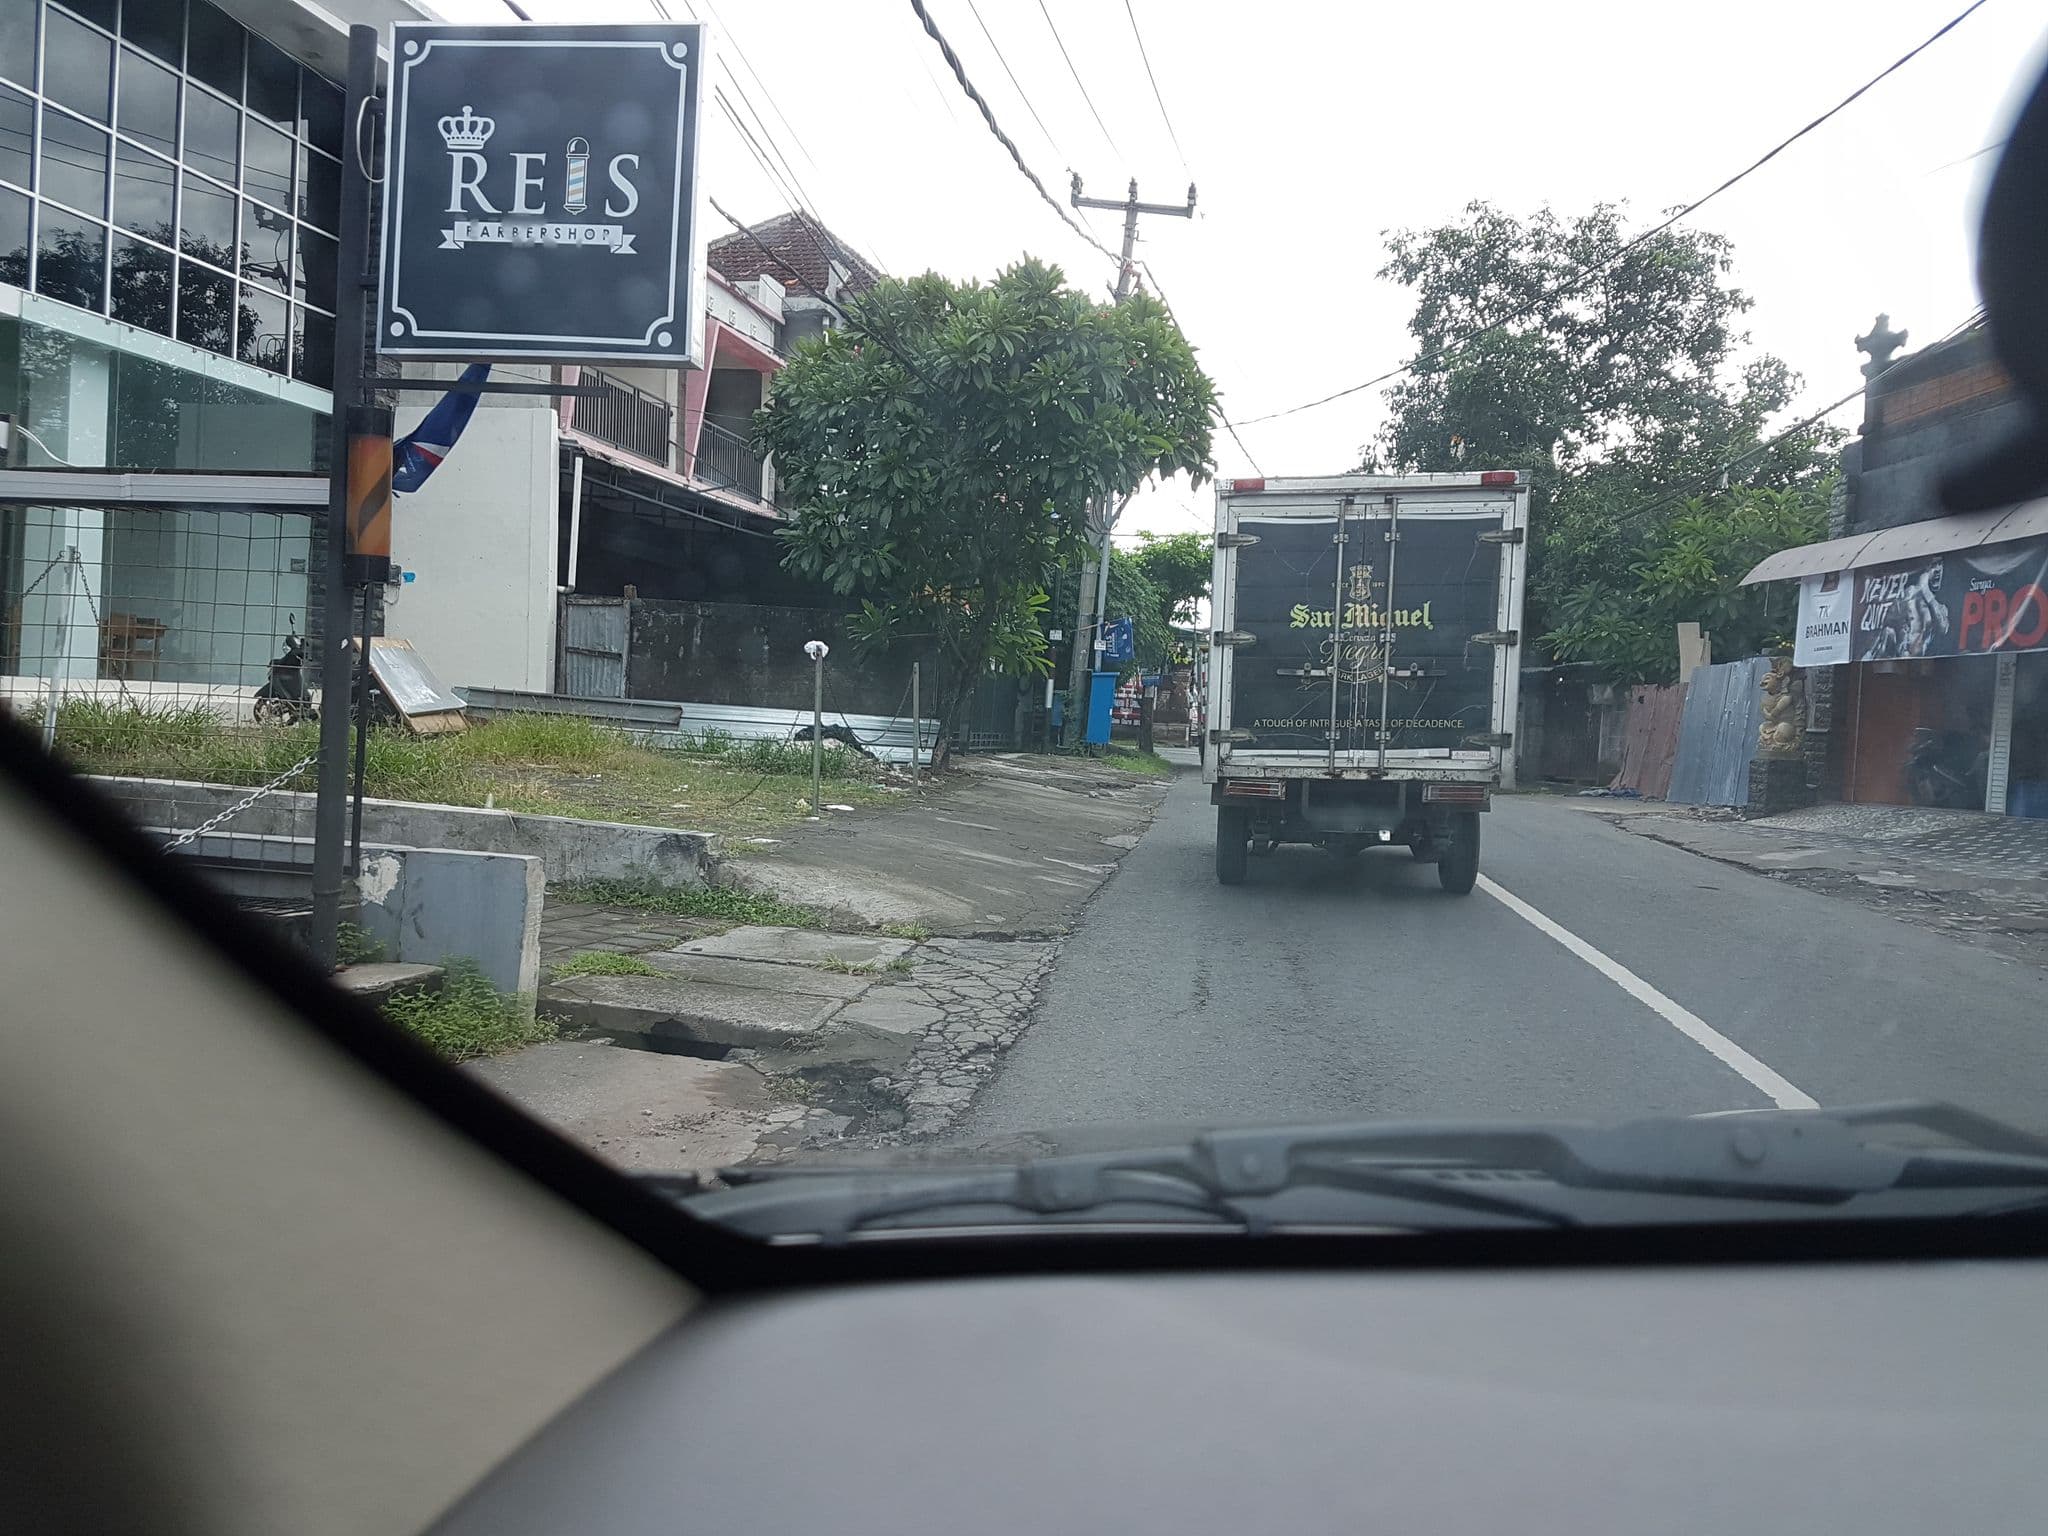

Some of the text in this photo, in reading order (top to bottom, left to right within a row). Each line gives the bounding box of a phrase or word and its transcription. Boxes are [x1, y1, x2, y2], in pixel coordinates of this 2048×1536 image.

[444, 138, 640, 218] REIS
[1860, 572, 1909, 603] NEVER
[1805, 620, 1850, 639] BRAHMAN
[1957, 584, 2048, 651] PRO
[1254, 719, 1261, 728] A
[1263, 719, 1294, 728] TOUCH
[1295, 719, 1308, 728] OF
[1391, 719, 1404, 728] OF
